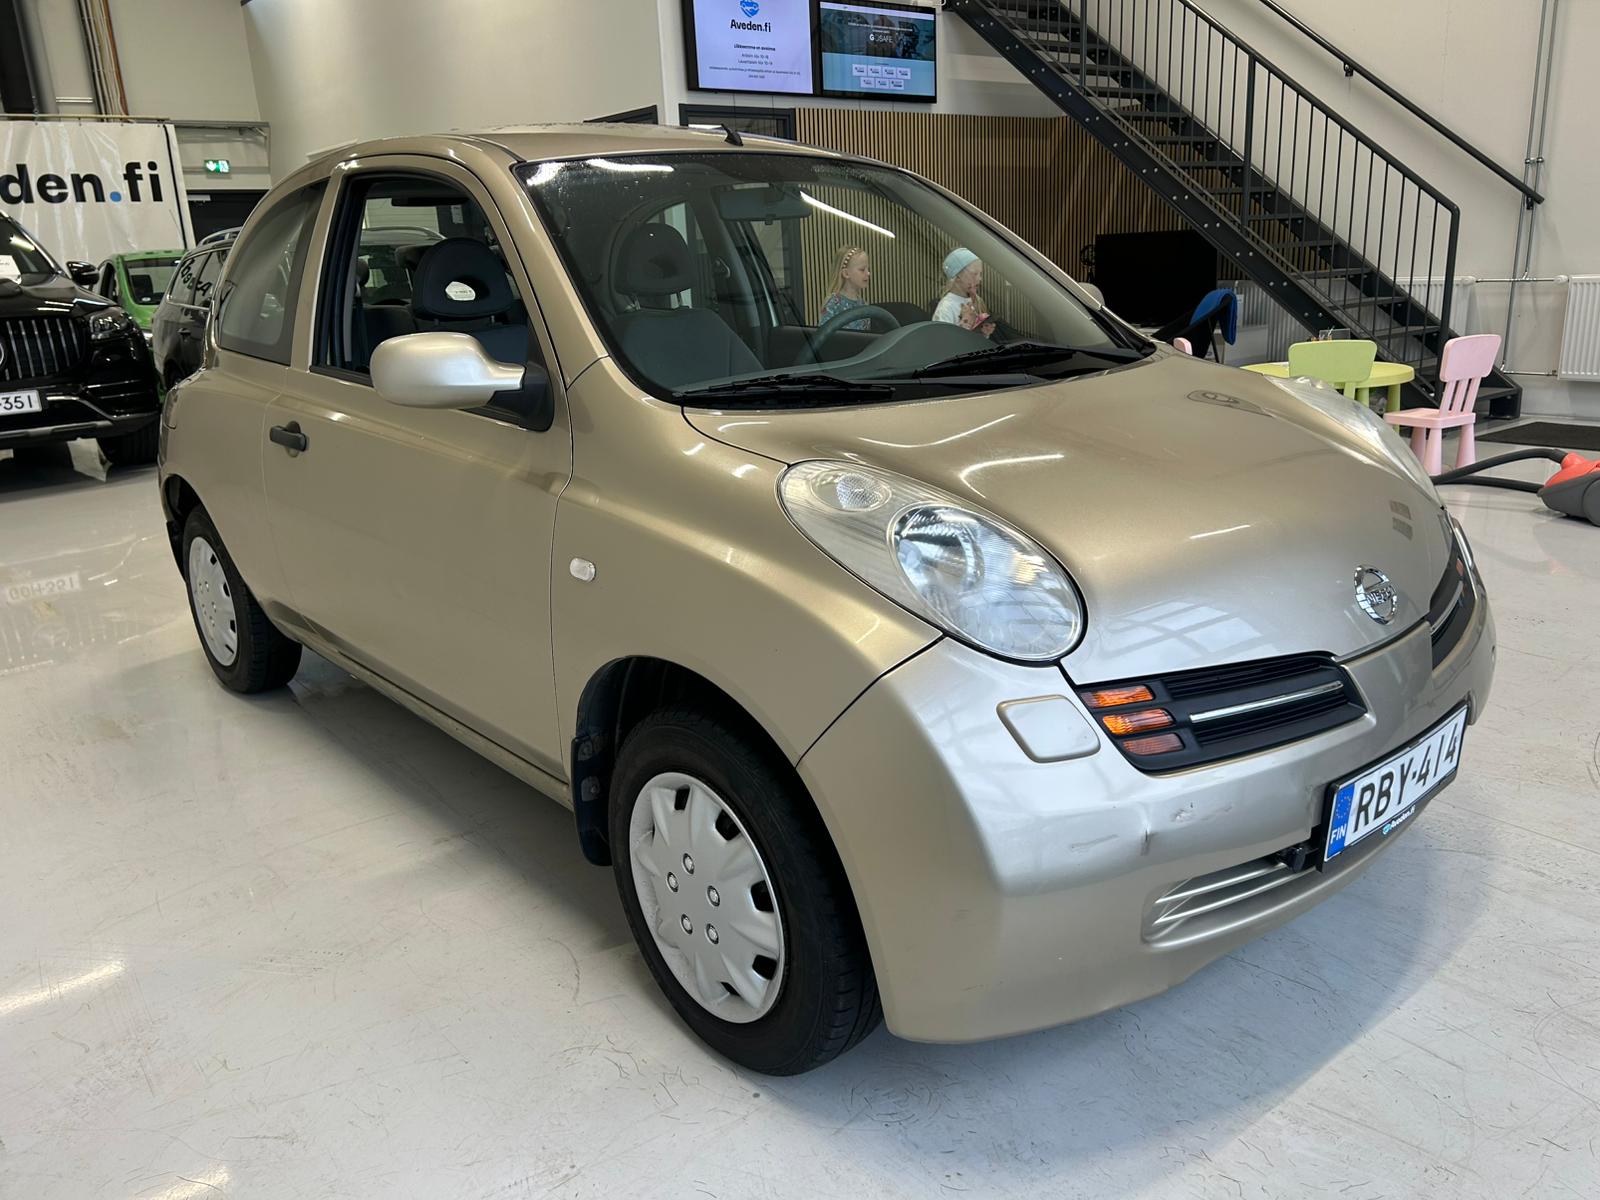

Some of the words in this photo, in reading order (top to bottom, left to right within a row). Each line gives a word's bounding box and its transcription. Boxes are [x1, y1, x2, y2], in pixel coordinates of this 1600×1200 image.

[730, 18, 771, 33] Aveden.fi
[0, 161, 163, 205] den.fi
[1352, 722, 1459, 834] RBY-414
[1330, 823, 1347, 845] FIN
